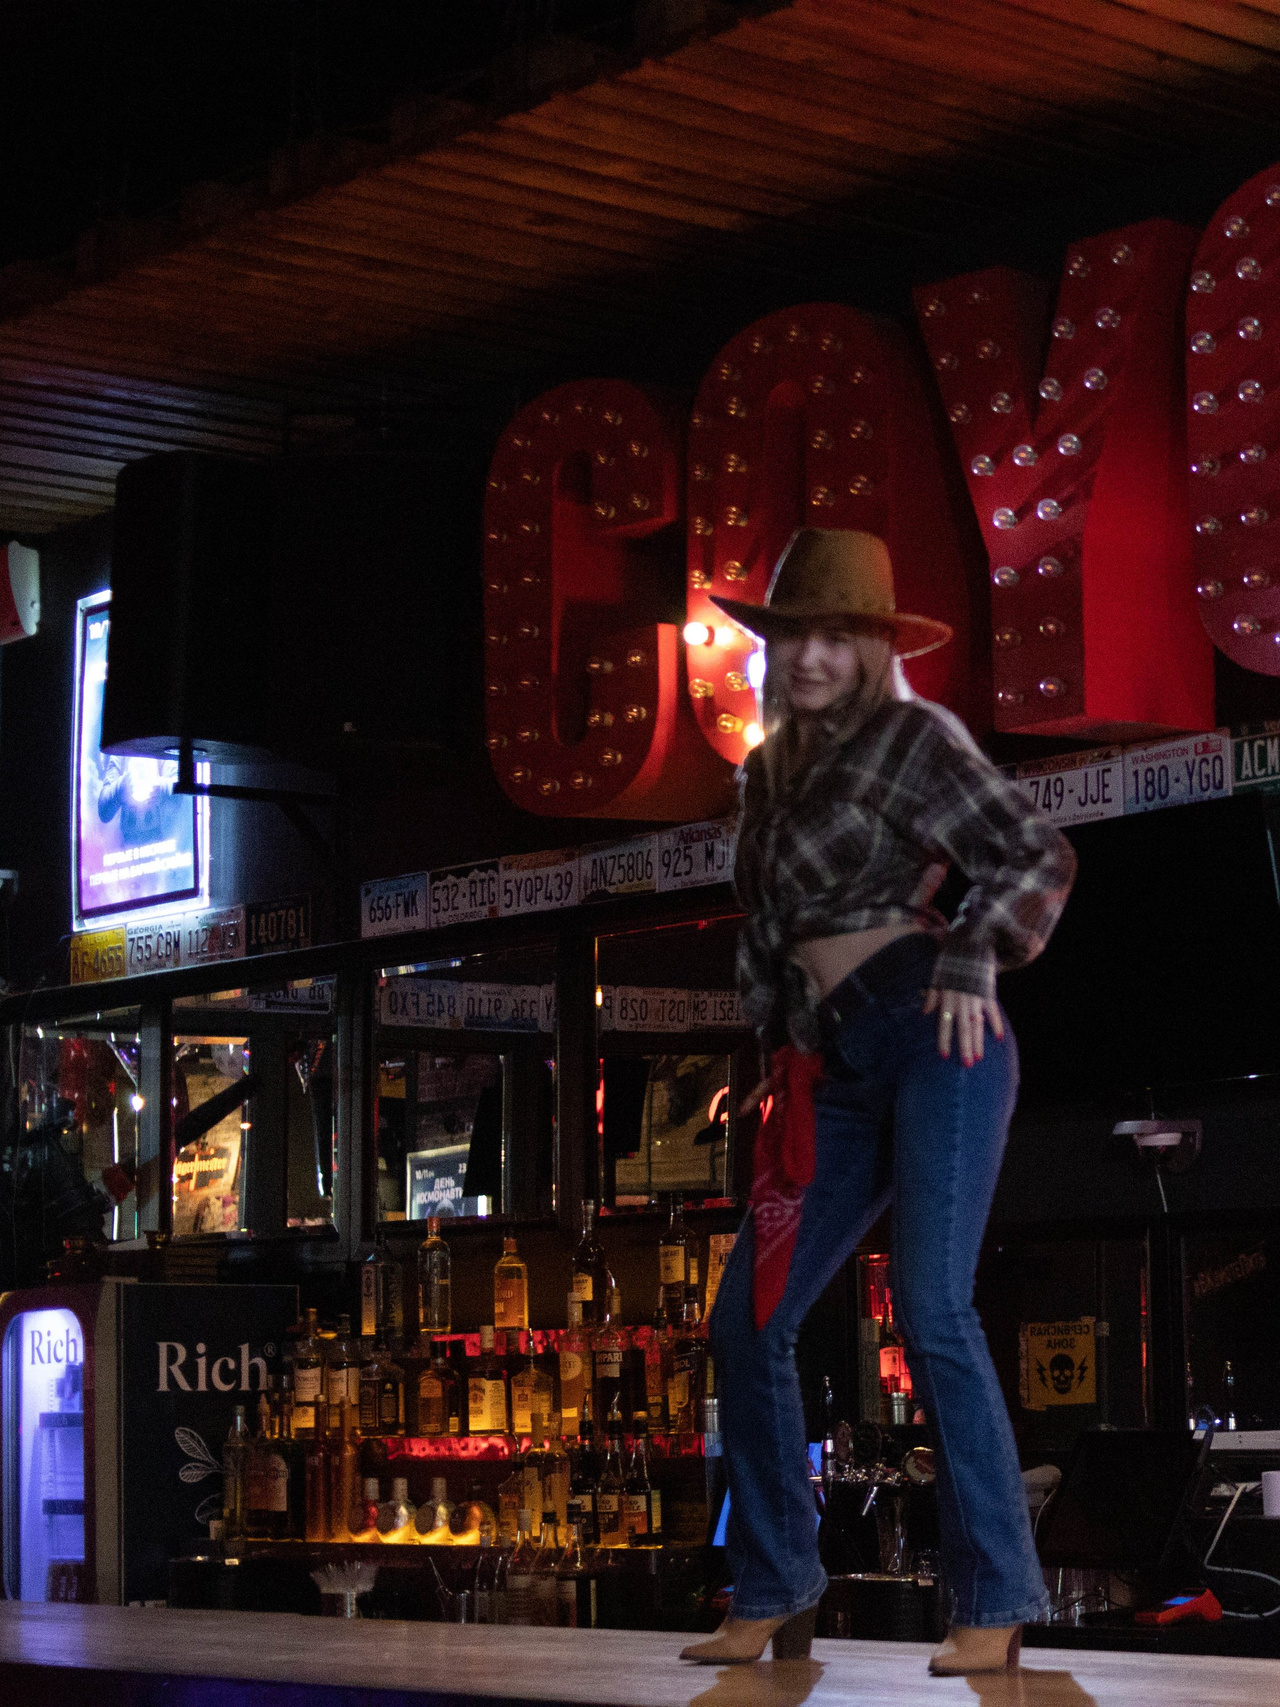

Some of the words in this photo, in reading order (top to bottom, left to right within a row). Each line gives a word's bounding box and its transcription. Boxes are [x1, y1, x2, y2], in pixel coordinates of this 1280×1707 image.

[1131, 747, 1190, 766] WASHINGTON
[1241, 737, 1280, 780] ACM
[677, 825, 723, 847] Arkansas
[590, 849, 653, 891] ANZ5806
[662, 845, 694, 879] 925
[503, 869, 573, 909] 5YQP439
[127, 924, 164, 936] GEORGIA
[447, 909, 483, 923] COLORADO
[128, 935, 153, 966] 755
[30, 1327, 78, 1365] Rich
[156, 1341, 268, 1392] Rich
